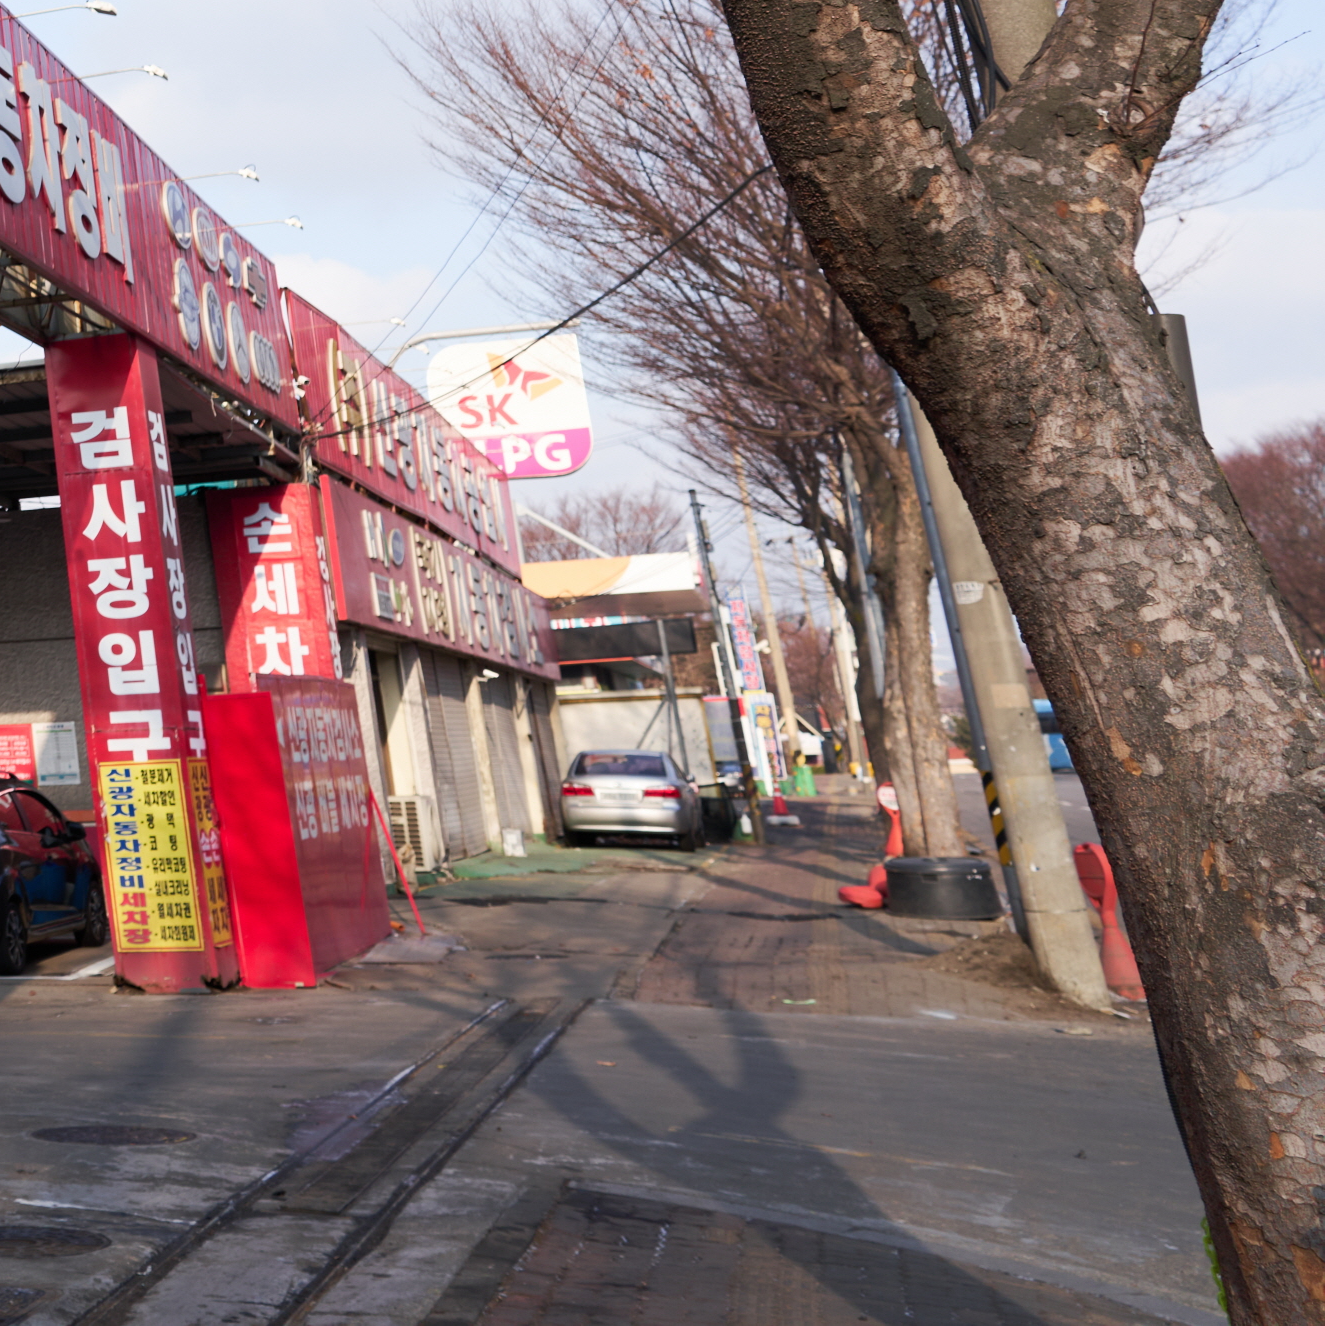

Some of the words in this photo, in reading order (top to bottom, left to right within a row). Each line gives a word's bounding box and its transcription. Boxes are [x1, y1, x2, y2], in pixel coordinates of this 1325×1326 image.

[458, 392, 520, 429] SK
[70, 405, 172, 763] 검사장입구
[147, 408, 207, 759] 검사장입구
[242, 501, 310, 676] 손세차
[151, 857, 187, 874] 유리막코팅
[155, 879, 190, 897] 실내크리닝
